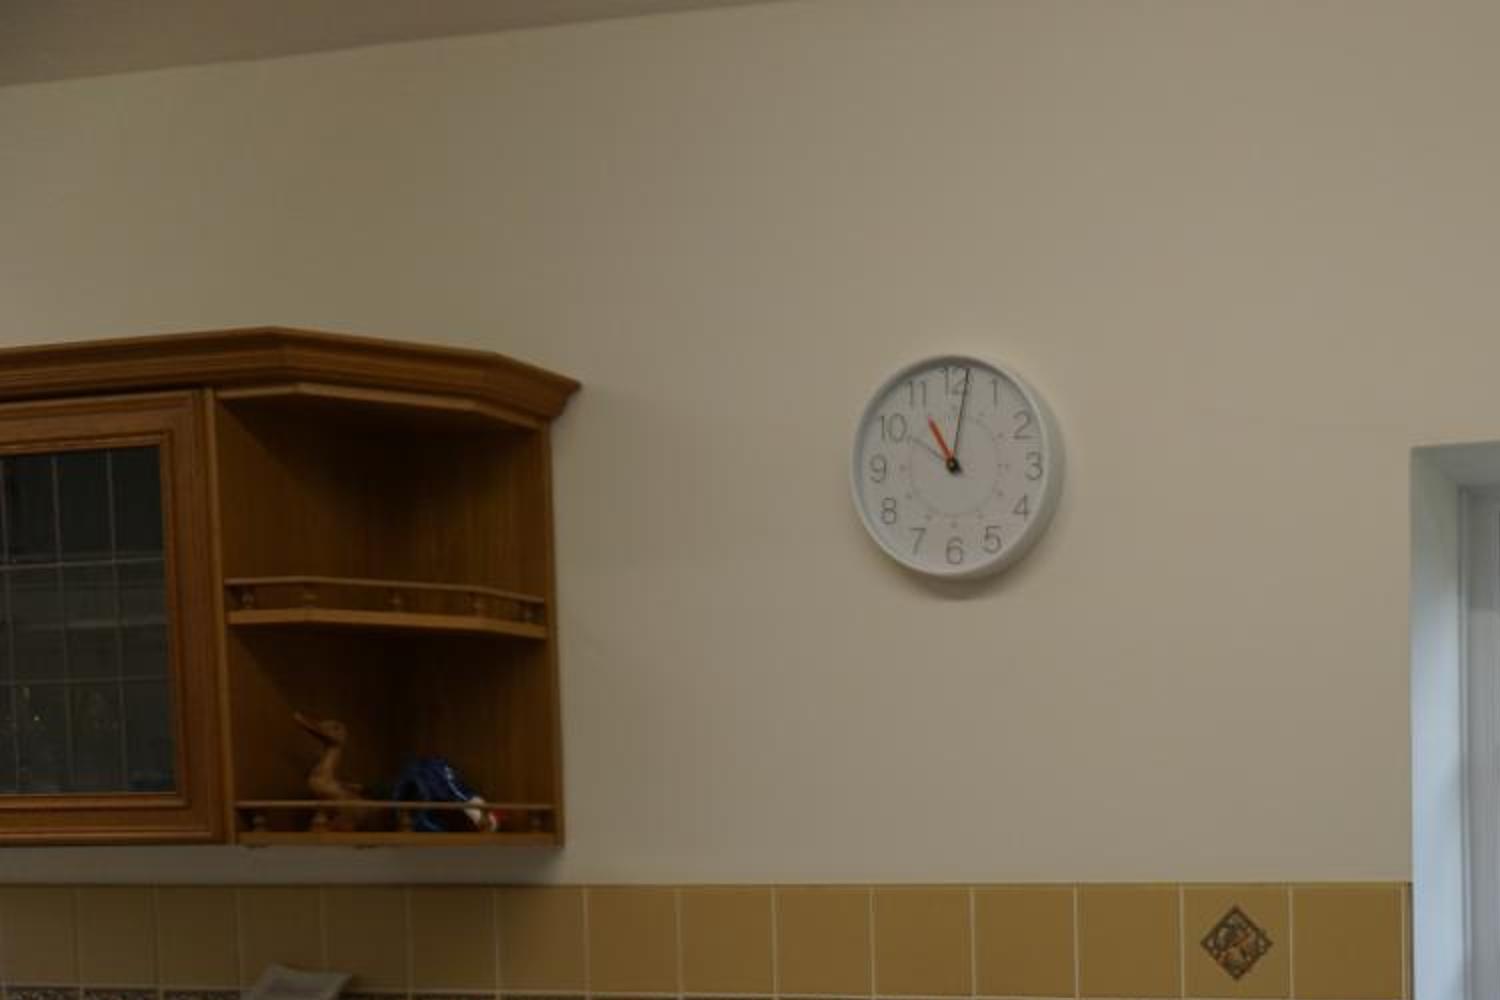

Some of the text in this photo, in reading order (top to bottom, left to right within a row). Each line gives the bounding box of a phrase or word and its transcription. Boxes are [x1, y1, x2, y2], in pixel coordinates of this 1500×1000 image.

[907, 379, 927, 407] 11
[880, 414, 907, 443] 10
[1013, 410, 1032, 439] 2
[869, 454, 887, 484] 9
[1025, 451, 1043, 481] 3
[880, 497, 897, 525] 8
[1012, 495, 1029, 520] 4
[909, 527, 926, 555] 7
[946, 537, 964, 565] 6
[984, 525, 1002, 554] 5
